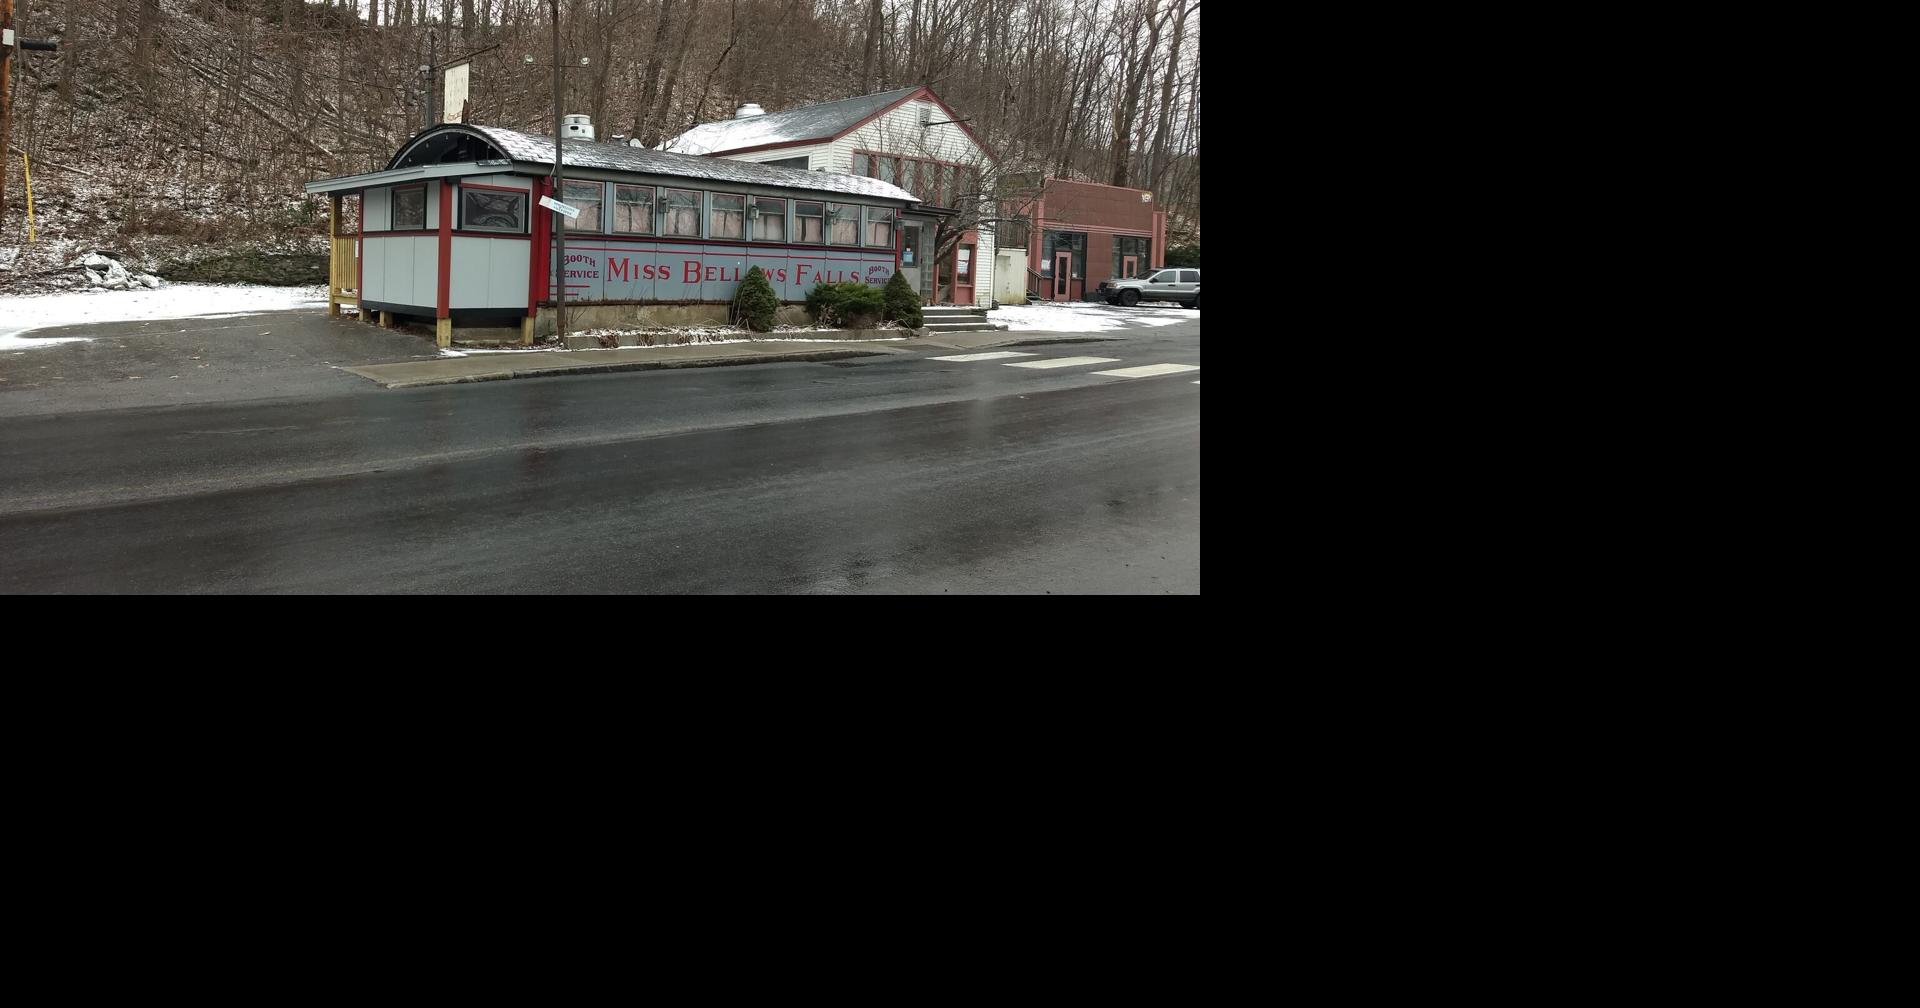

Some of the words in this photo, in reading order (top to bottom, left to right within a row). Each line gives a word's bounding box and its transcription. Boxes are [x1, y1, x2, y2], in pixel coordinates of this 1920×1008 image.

[556, 270, 600, 279] ERVICE
[607, 257, 671, 282] MISS
[682, 260, 787, 284] BELLWS
[795, 263, 860, 286] FALLS
[868, 265, 890, 276] BOOTH
